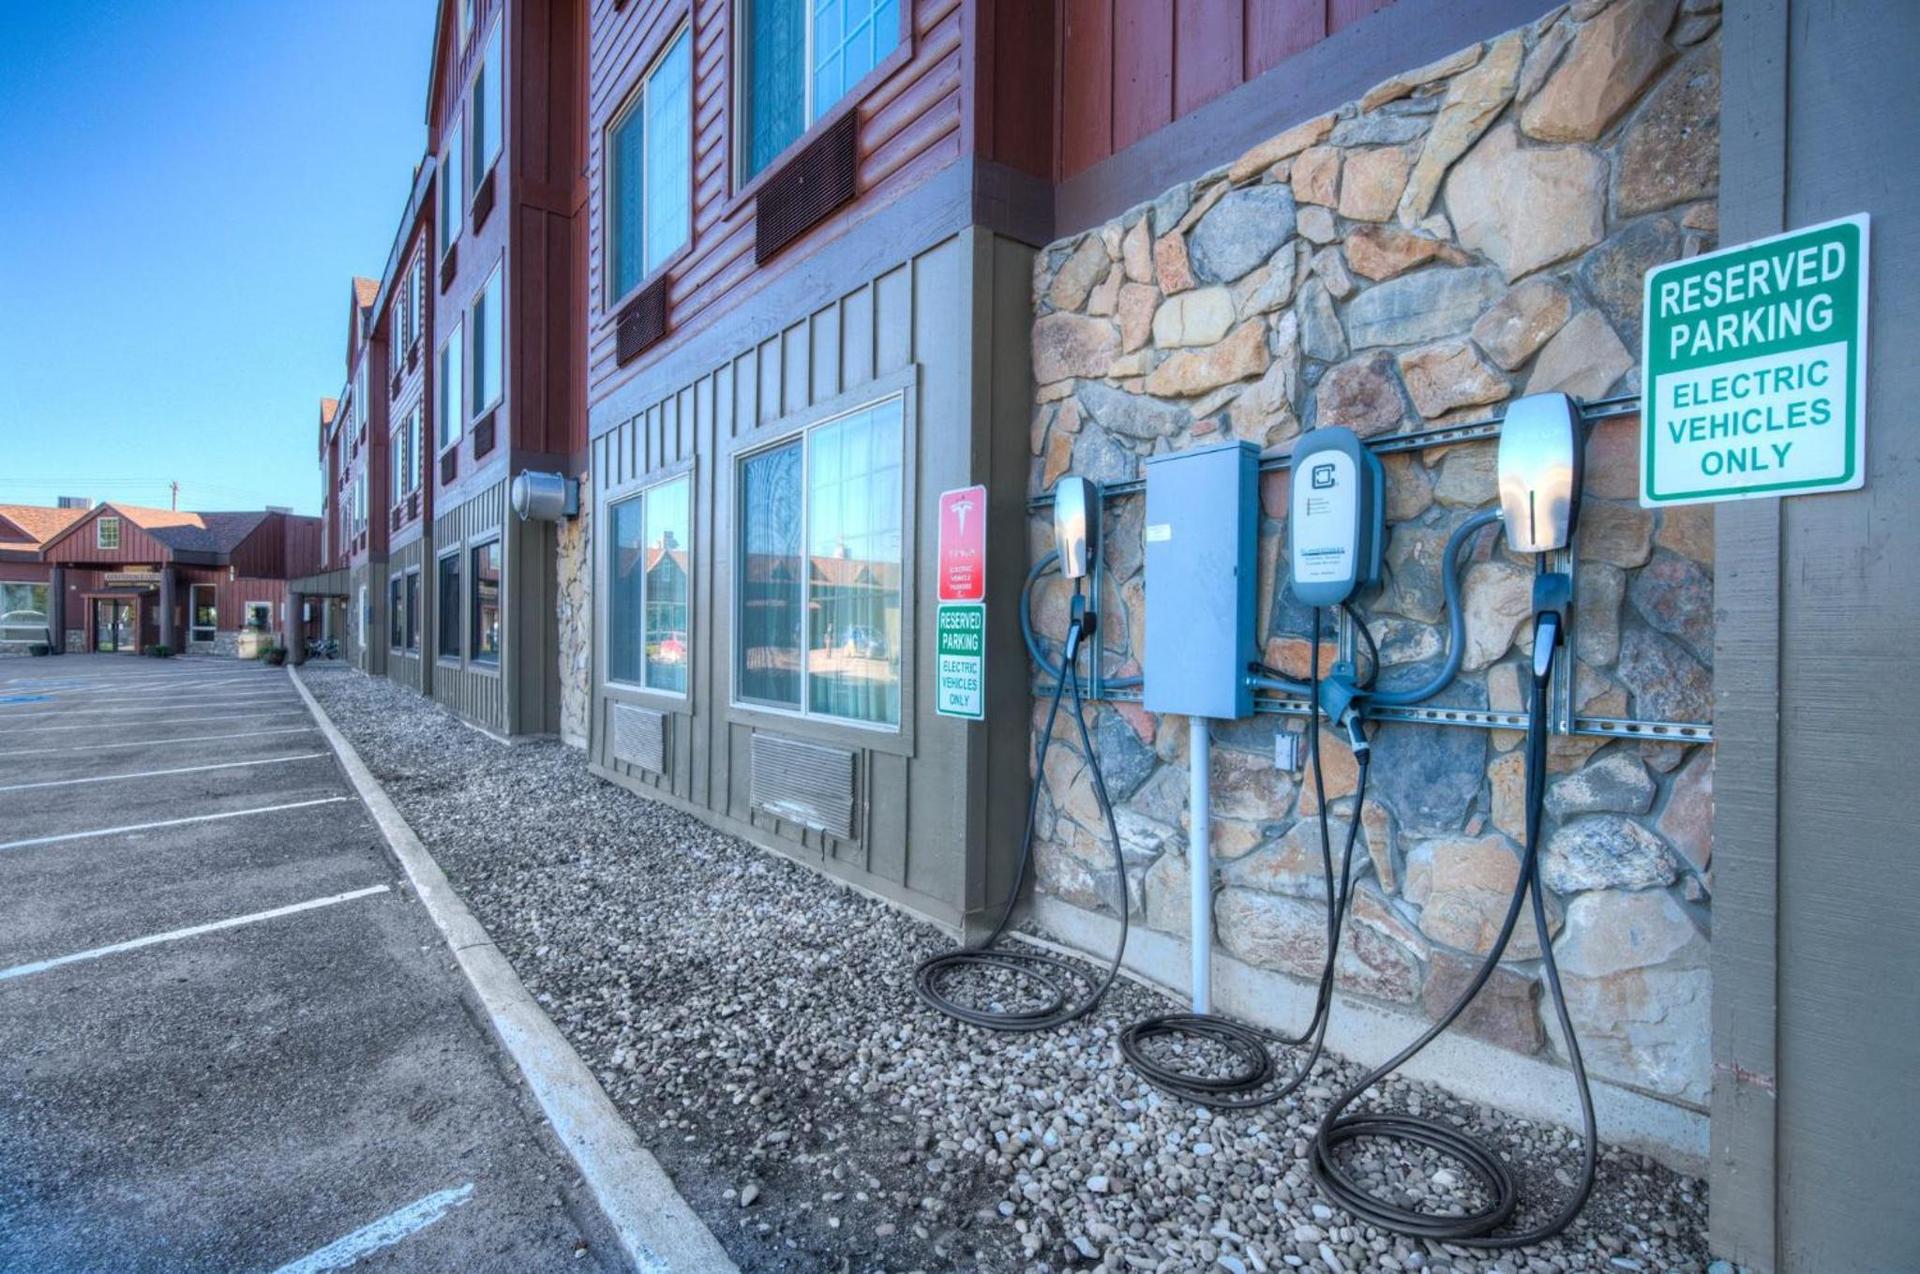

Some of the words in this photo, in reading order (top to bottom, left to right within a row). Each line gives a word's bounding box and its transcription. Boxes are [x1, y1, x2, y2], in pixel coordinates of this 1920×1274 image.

[1660, 241, 1846, 318] RESERVED
[1670, 293, 1833, 360] PARKING
[1673, 360, 1829, 409] ELECTRIC
[1668, 398, 1831, 444] VEHICLES
[1701, 442, 1793, 477] ONLY
[941, 612, 981, 629] RESERVED
[942, 633, 979, 651] PARKING
[943, 660, 977, 673] ELECTRIC
[942, 677, 977, 691] VEHICLES
[950, 693, 970, 706] ONLY
